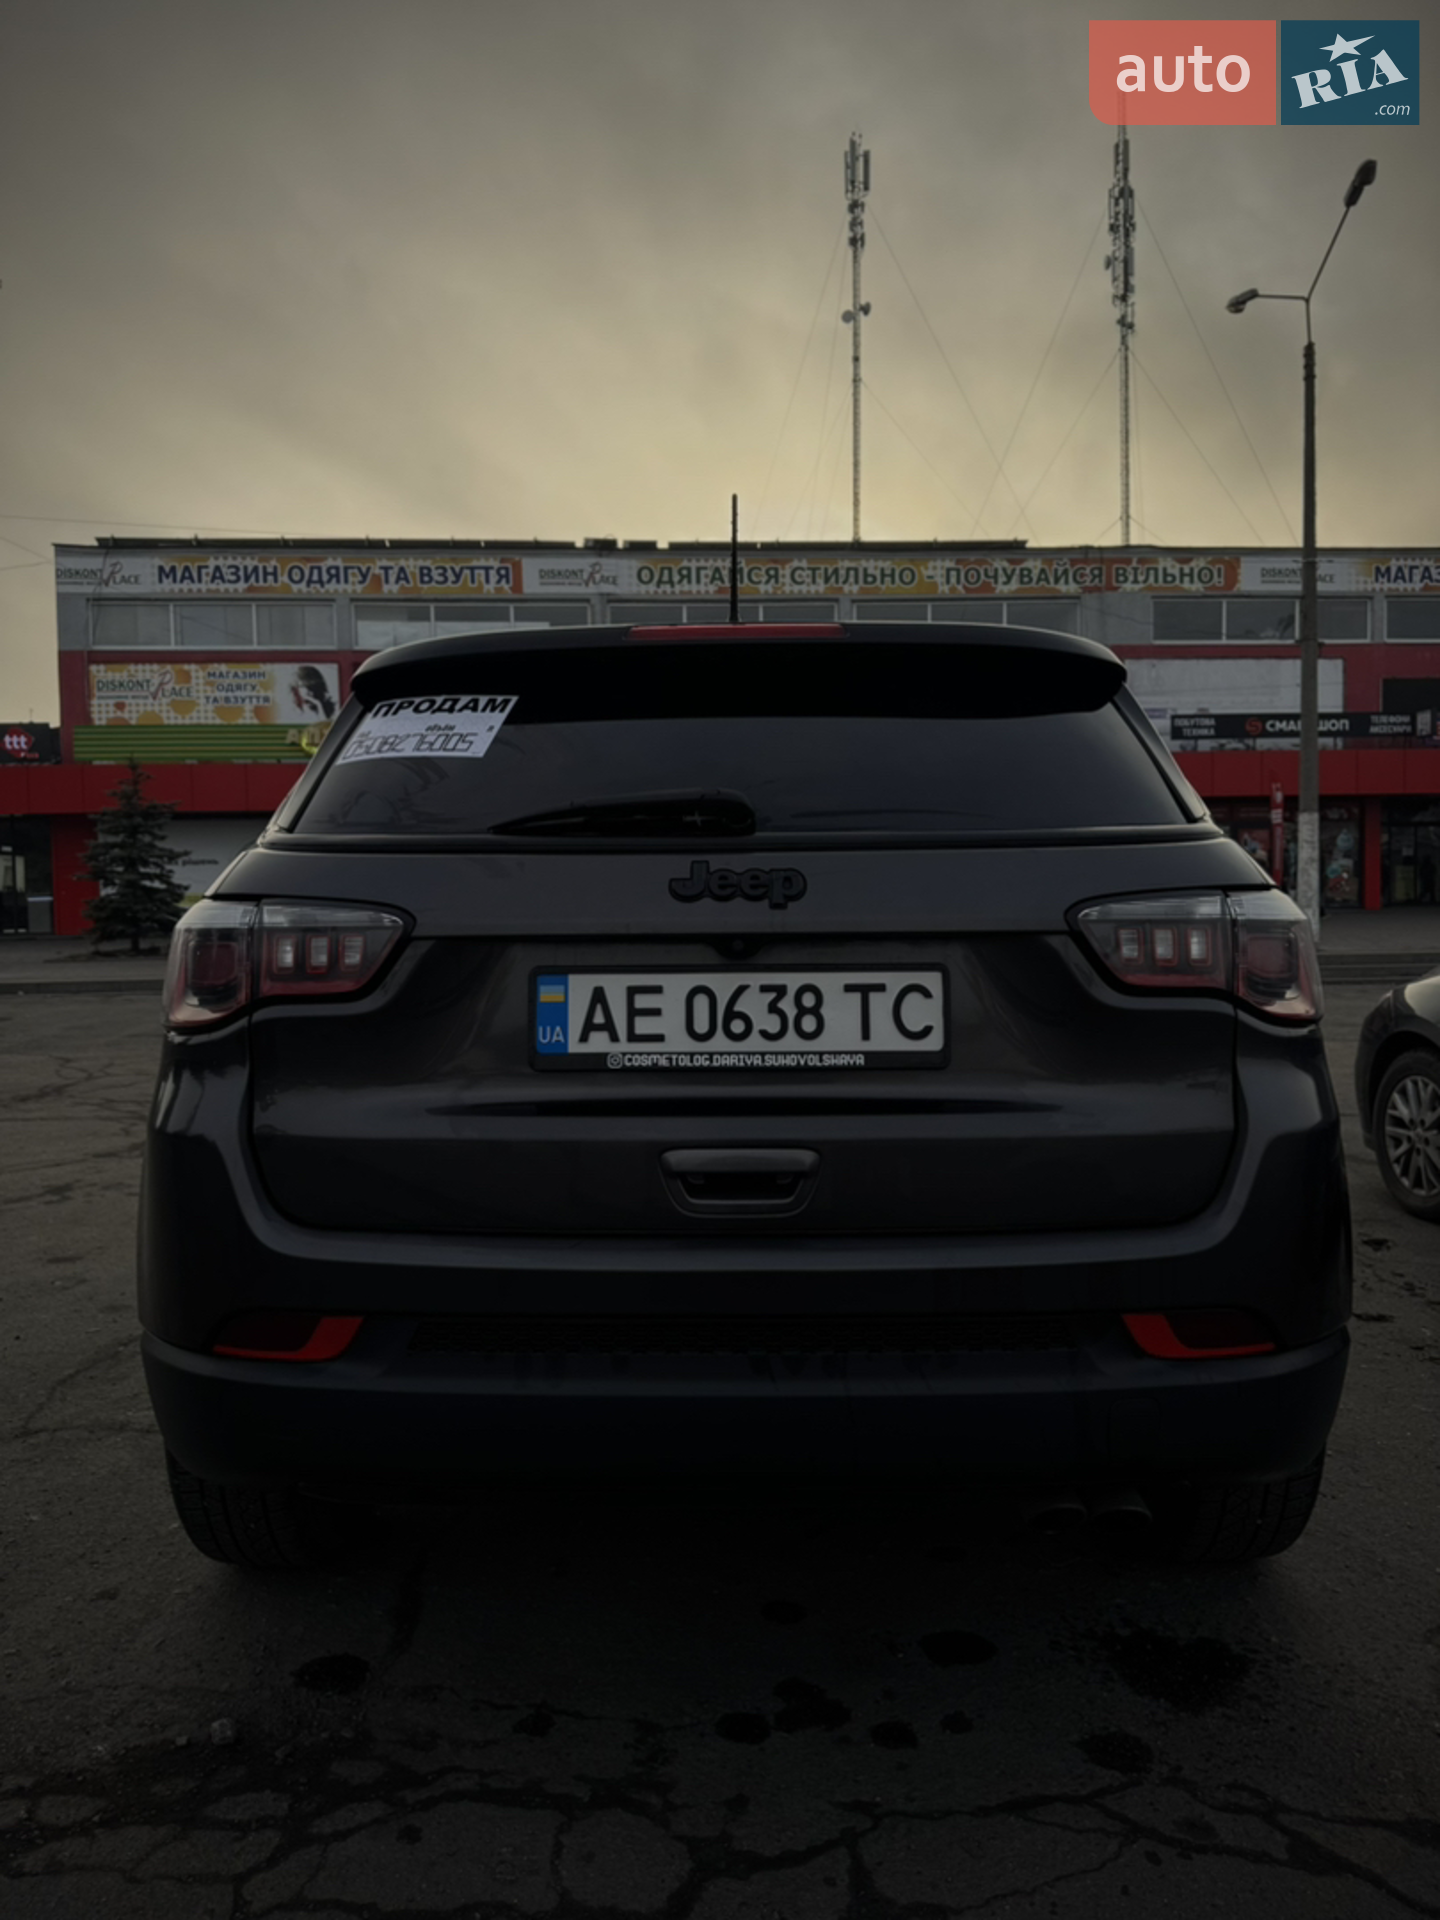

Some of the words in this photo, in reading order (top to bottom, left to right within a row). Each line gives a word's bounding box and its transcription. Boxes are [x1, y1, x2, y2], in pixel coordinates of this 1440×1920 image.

[56, 568, 103, 579] DISKONT
[158, 565, 278, 584] МАГАЗИН
[287, 565, 371, 587] ОДЯГУ
[379, 565, 411, 585] ТА
[419, 565, 511, 585] ВЗУТТЯ
[539, 568, 584, 579] DISKONT
[637, 560, 779, 587] ОДЯГАЙСЯ
[790, 566, 917, 585] СТИЛЬНО
[946, 561, 1103, 585] ПОЧУВАЙСЯ
[1114, 566, 1224, 585] ВІЛЬНО!
[207, 671, 266, 681] МАГАЗИН
[97, 679, 151, 692] DISKONT
[216, 683, 257, 694] ОДЯГУ
[205, 695, 220, 705] ТА
[223, 695, 271, 705] ВЗУТТЯ
[373, 697, 513, 718] ПРОДАМ
[1265, 719, 1349, 732] СМАШОП
[669, 860, 807, 909] Jeep
[578, 984, 665, 1043] AE
[685, 983, 825, 1042] 0638
[844, 982, 934, 1041] TC
[538, 1026, 565, 1044] UA
